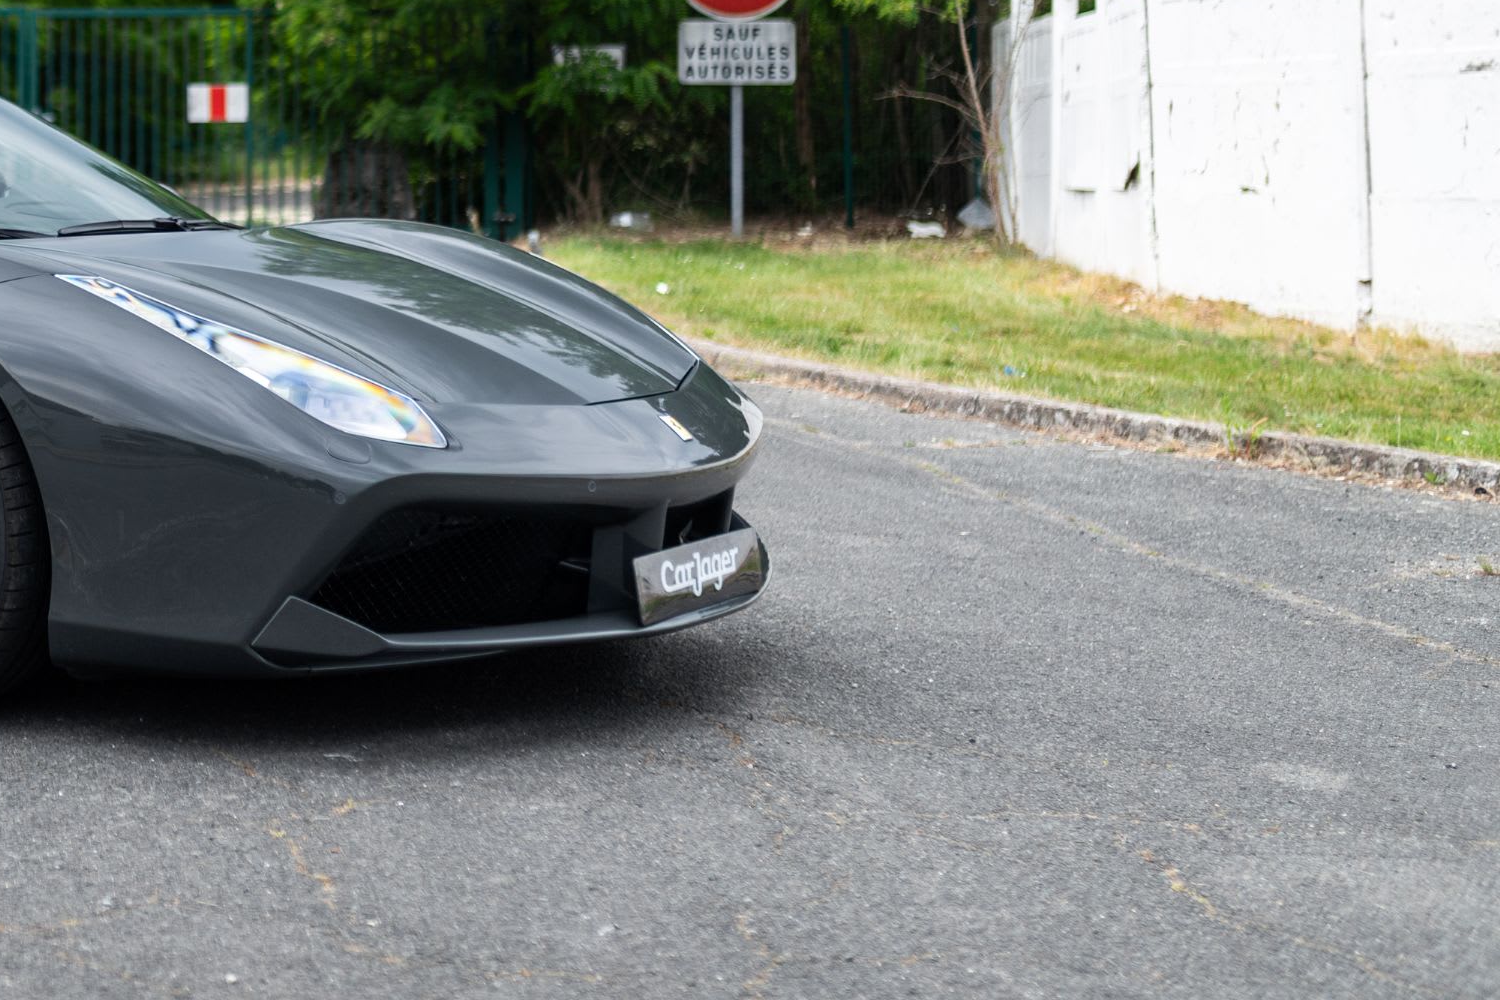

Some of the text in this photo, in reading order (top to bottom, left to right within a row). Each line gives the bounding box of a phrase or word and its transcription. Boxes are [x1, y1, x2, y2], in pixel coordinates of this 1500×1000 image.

[714, 27, 761, 41] SAUF
[685, 42, 789, 60] VÉHICULES
[685, 63, 789, 80] AUTORISÉS
[660, 547, 738, 597] CarJager
